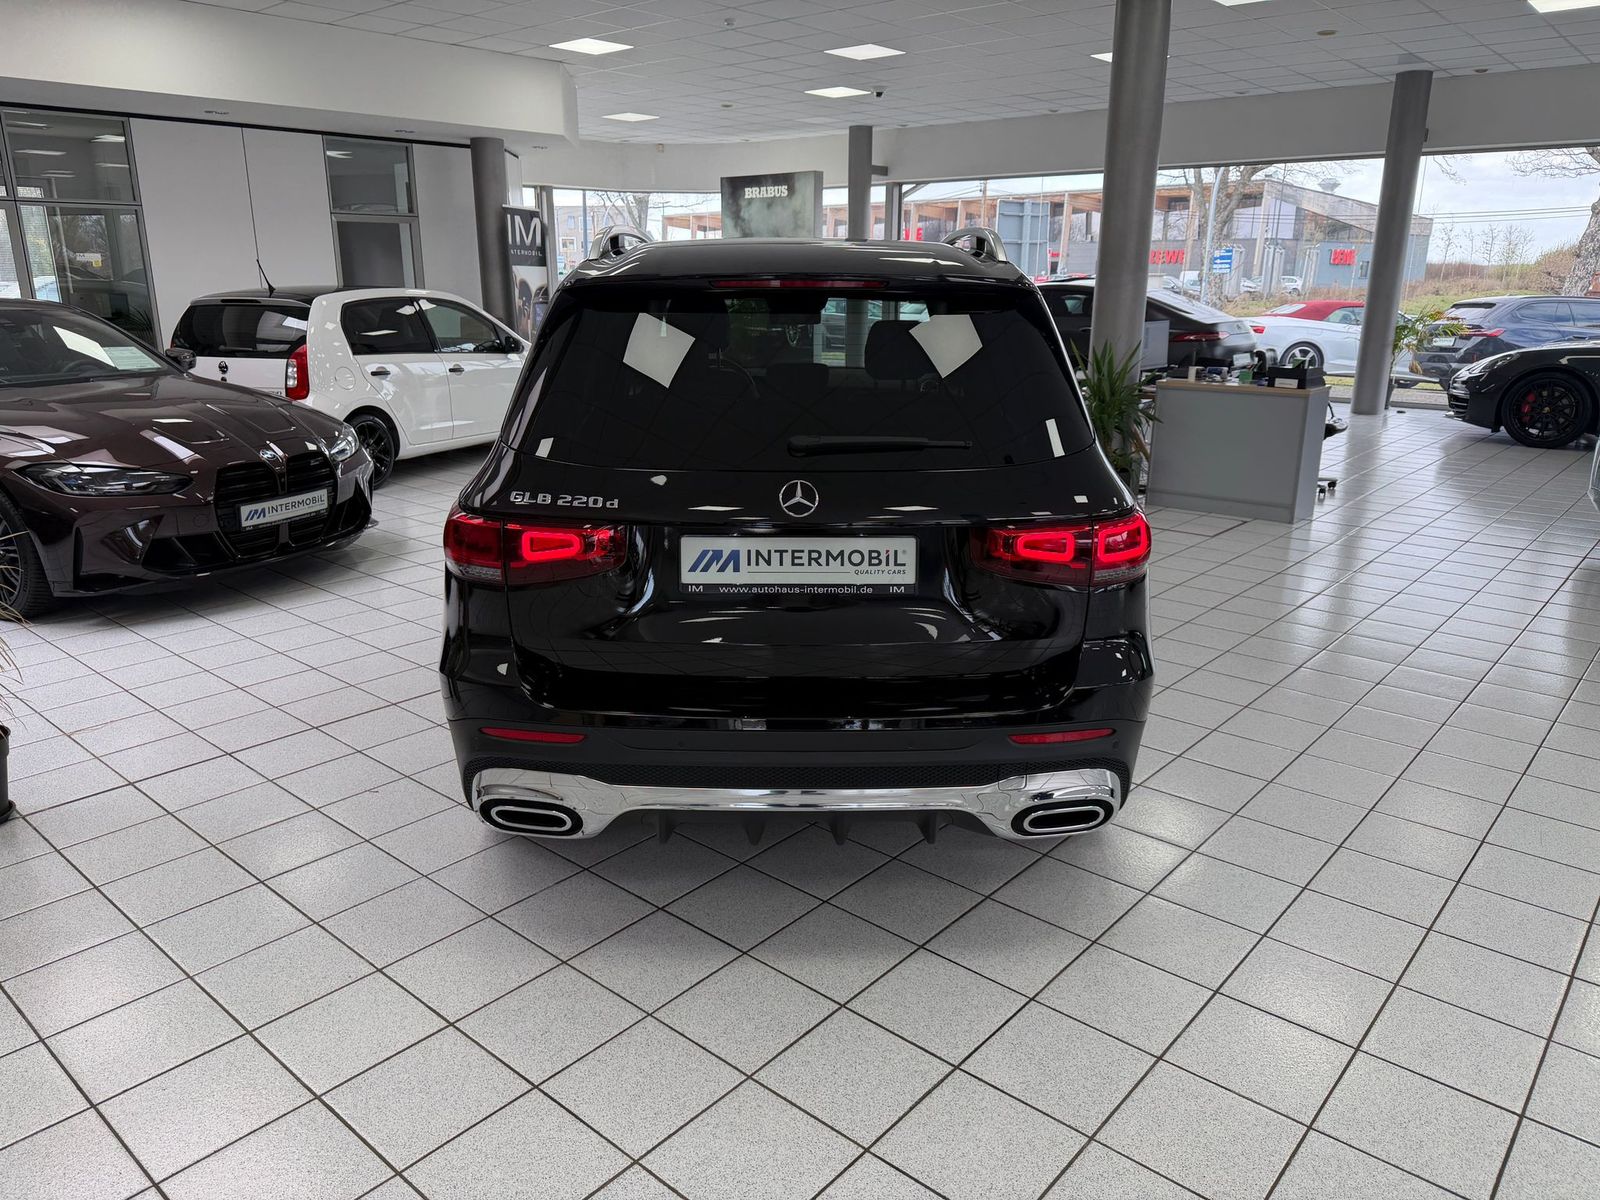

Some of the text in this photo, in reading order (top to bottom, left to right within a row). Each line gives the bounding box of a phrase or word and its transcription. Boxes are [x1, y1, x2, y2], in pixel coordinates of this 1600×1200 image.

[744, 185, 788, 198] BRABUS
[507, 214, 542, 247] IM
[510, 491, 551, 504] GLB
[719, 586, 873, 594] www.autohaus-intermobil.de
